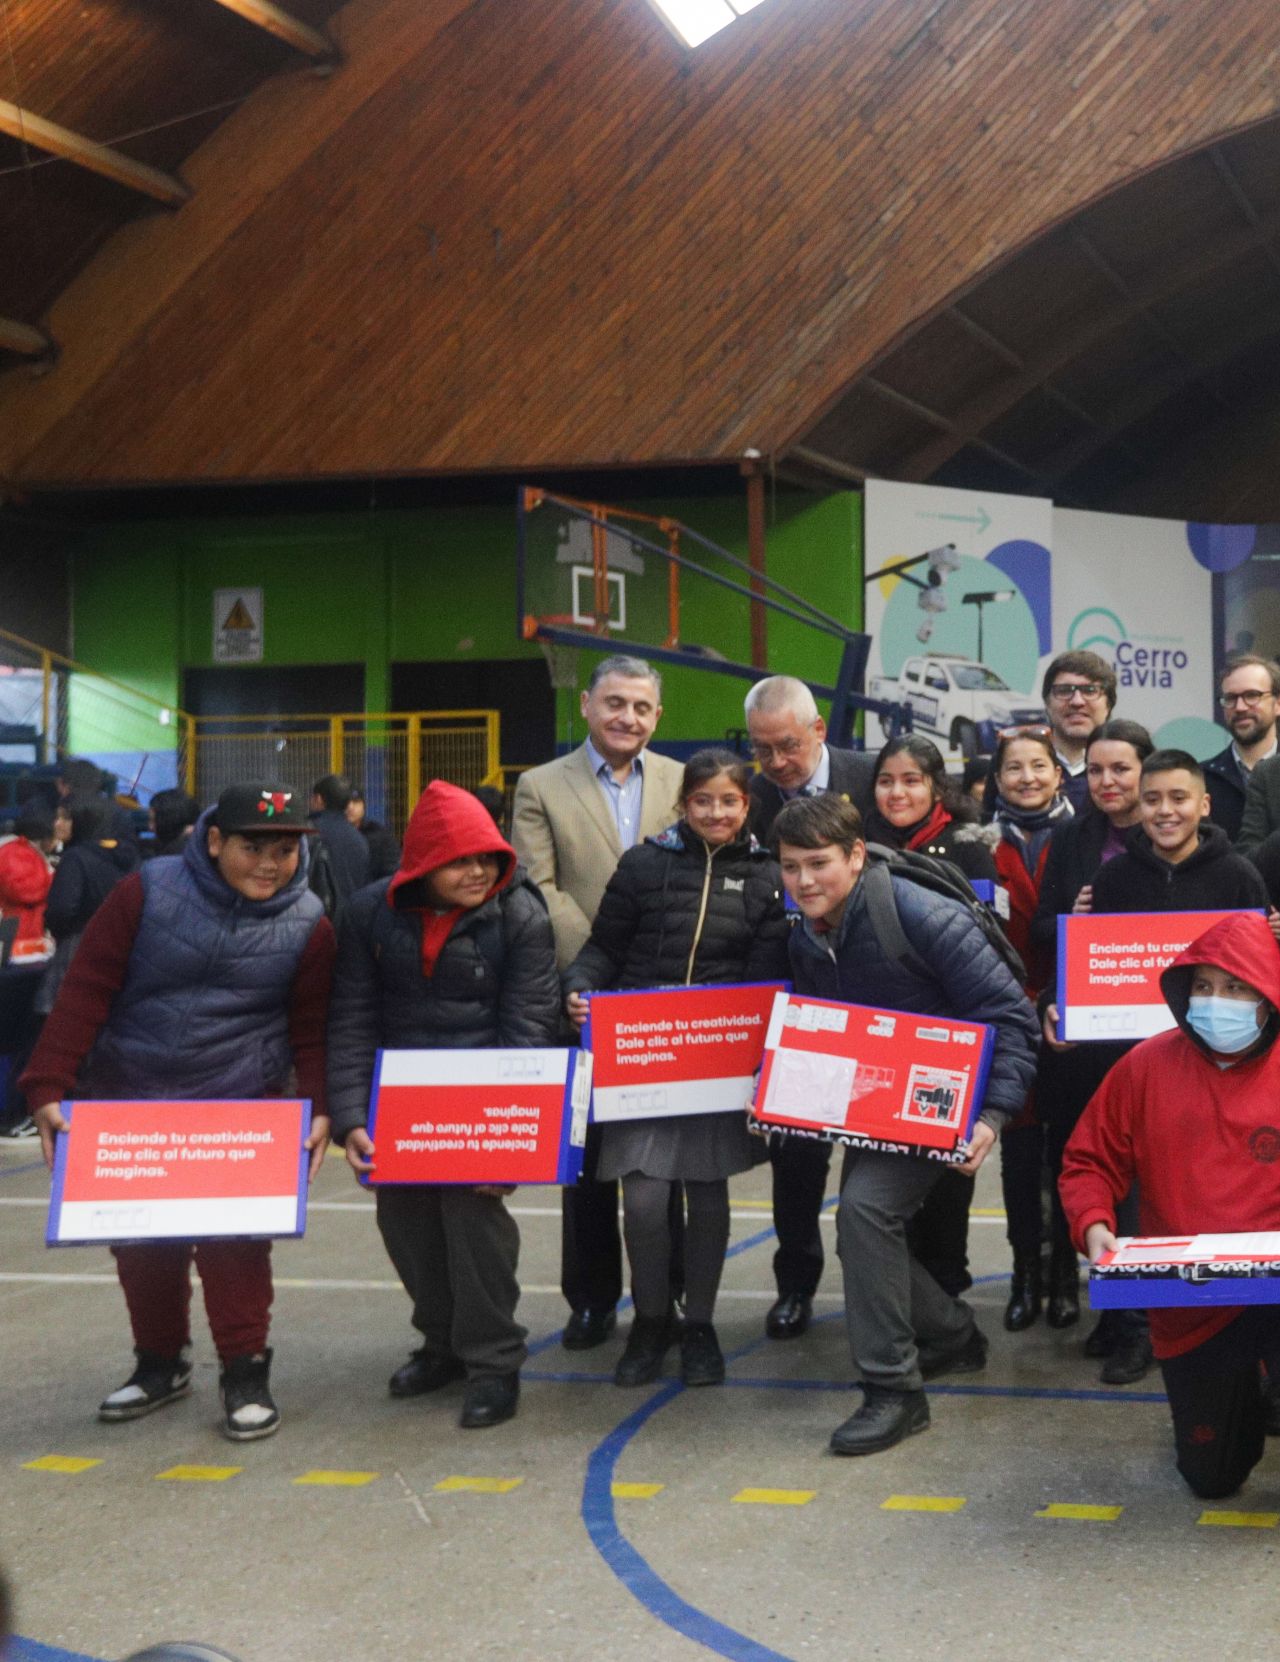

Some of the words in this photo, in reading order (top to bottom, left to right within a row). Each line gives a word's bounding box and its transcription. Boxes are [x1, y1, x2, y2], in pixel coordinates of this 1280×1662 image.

[1116, 642, 1188, 669] Cerro
[1113, 662, 1172, 688] avia
[1089, 943, 1145, 954] Enciende
[1147, 943, 1160, 952] tu
[1089, 958, 1117, 969] Dale
[1120, 958, 1140, 968] clic
[1143, 957, 1154, 967] al
[1089, 973, 1147, 986] imaginas.
[615, 1022, 672, 1034] Enciende
[675, 1021, 688, 1030] tu
[691, 1014, 763, 1028] creatividad.
[616, 1037, 644, 1049] Dale
[648, 1036, 668, 1047] clic
[672, 1035, 683, 1045] al
[686, 1033, 723, 1045] futuro
[725, 1031, 748, 1043] que
[617, 1053, 677, 1065] imaginas.
[483, 1107, 540, 1119] imaginas.
[412, 1121, 434, 1133] que
[436, 1124, 471, 1134] futuro
[475, 1124, 486, 1134] al
[489, 1124, 507, 1134] clic
[511, 1124, 538, 1134] Dale
[98, 1131, 167, 1144] Enciende
[170, 1132, 186, 1144] tu
[190, 1131, 274, 1143] creatividad.
[396, 1140, 464, 1152] creatividad.
[468, 1140, 479, 1150] tu
[482, 1140, 537, 1151] Enciende
[97, 1148, 130, 1162] Dale
[135, 1148, 160, 1160] clic
[164, 1149, 178, 1160] al
[181, 1148, 225, 1160] futuro
[229, 1149, 256, 1162] que
[96, 1165, 168, 1180] imaginas.
